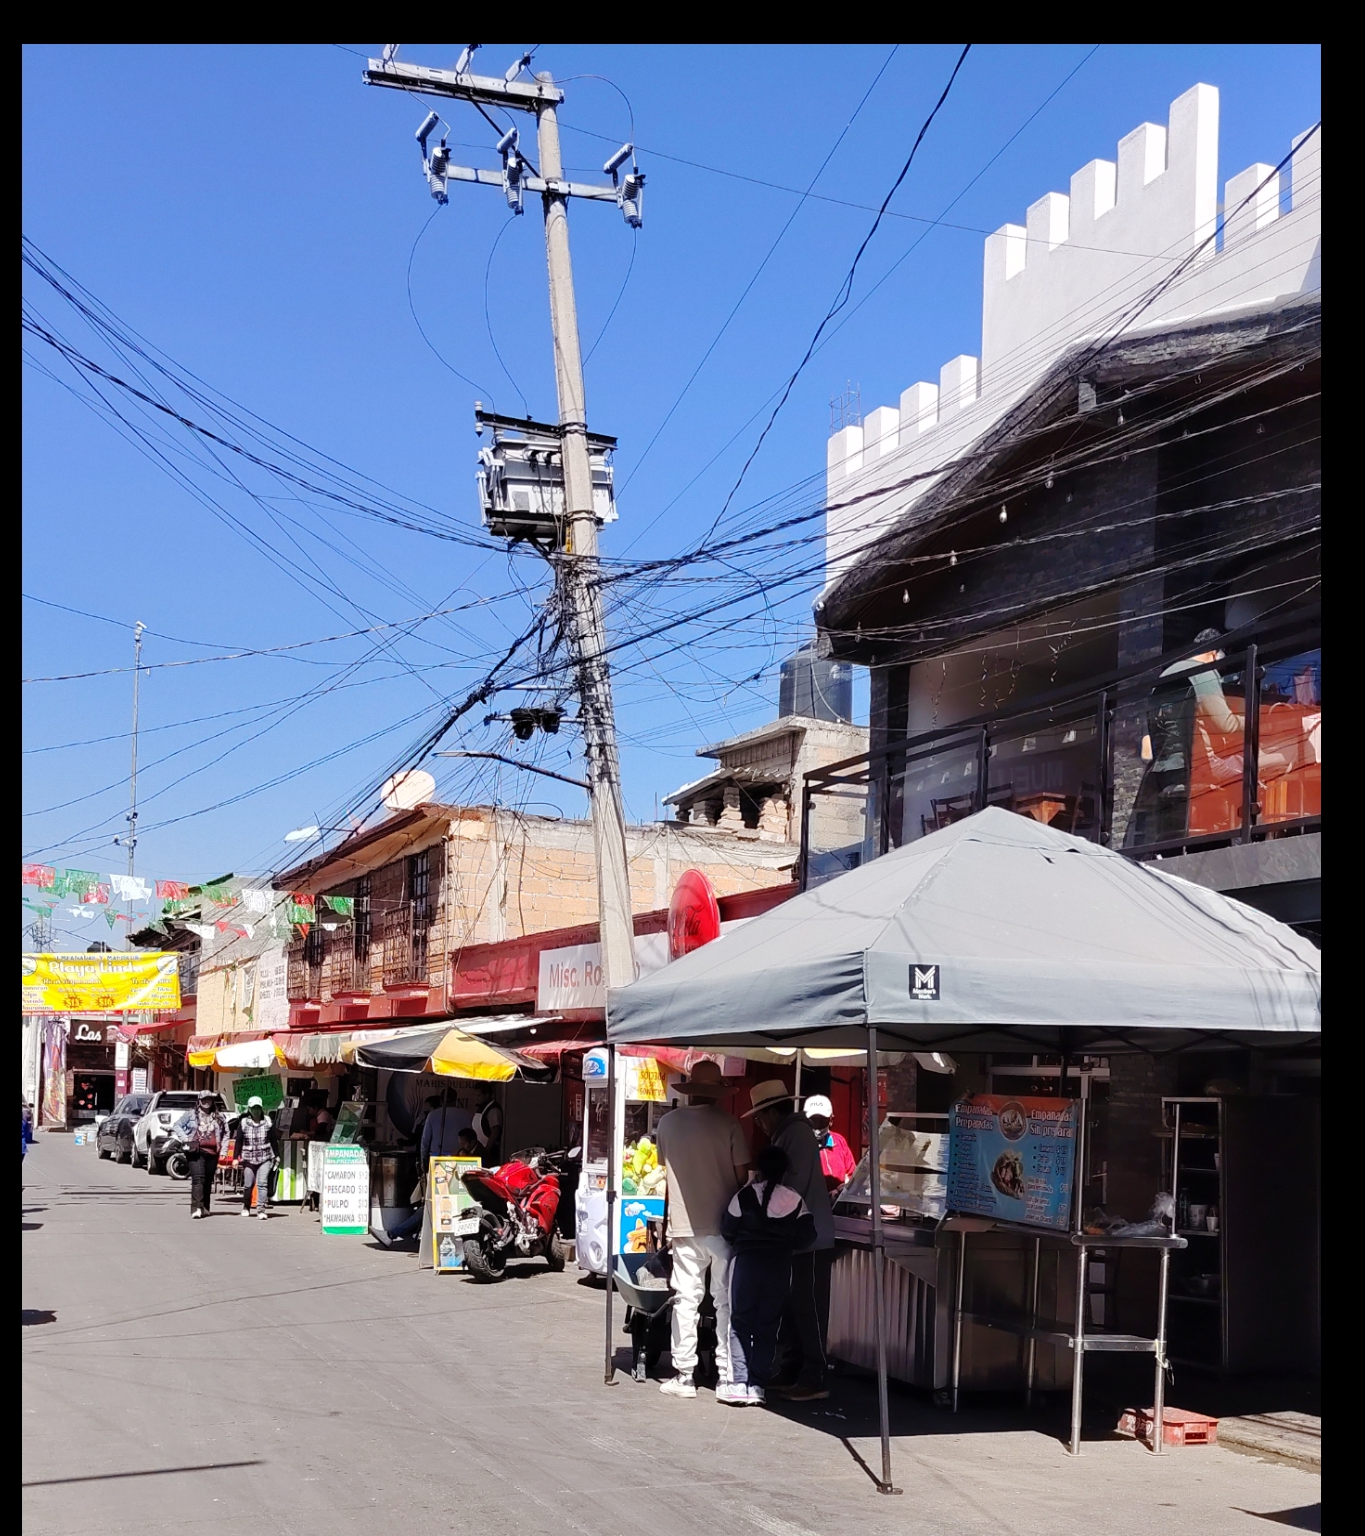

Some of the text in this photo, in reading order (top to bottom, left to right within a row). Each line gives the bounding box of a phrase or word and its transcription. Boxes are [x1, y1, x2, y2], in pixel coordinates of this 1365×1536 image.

[49, 960, 145, 977] Playa Linda
[549, 962, 581, 989] Misc.
[74, 1024, 102, 1042] Las
[955, 1103, 993, 1116] Empanadas
[1031, 1109, 1073, 1122] Empanadas
[955, 1116, 994, 1130] Preparadas
[1029, 1123, 1042, 1135] Sin
[327, 1185, 356, 1194] PESCADO
[327, 1199, 349, 1209] PULPO
[326, 1213, 355, 1223] HAWAIANA
